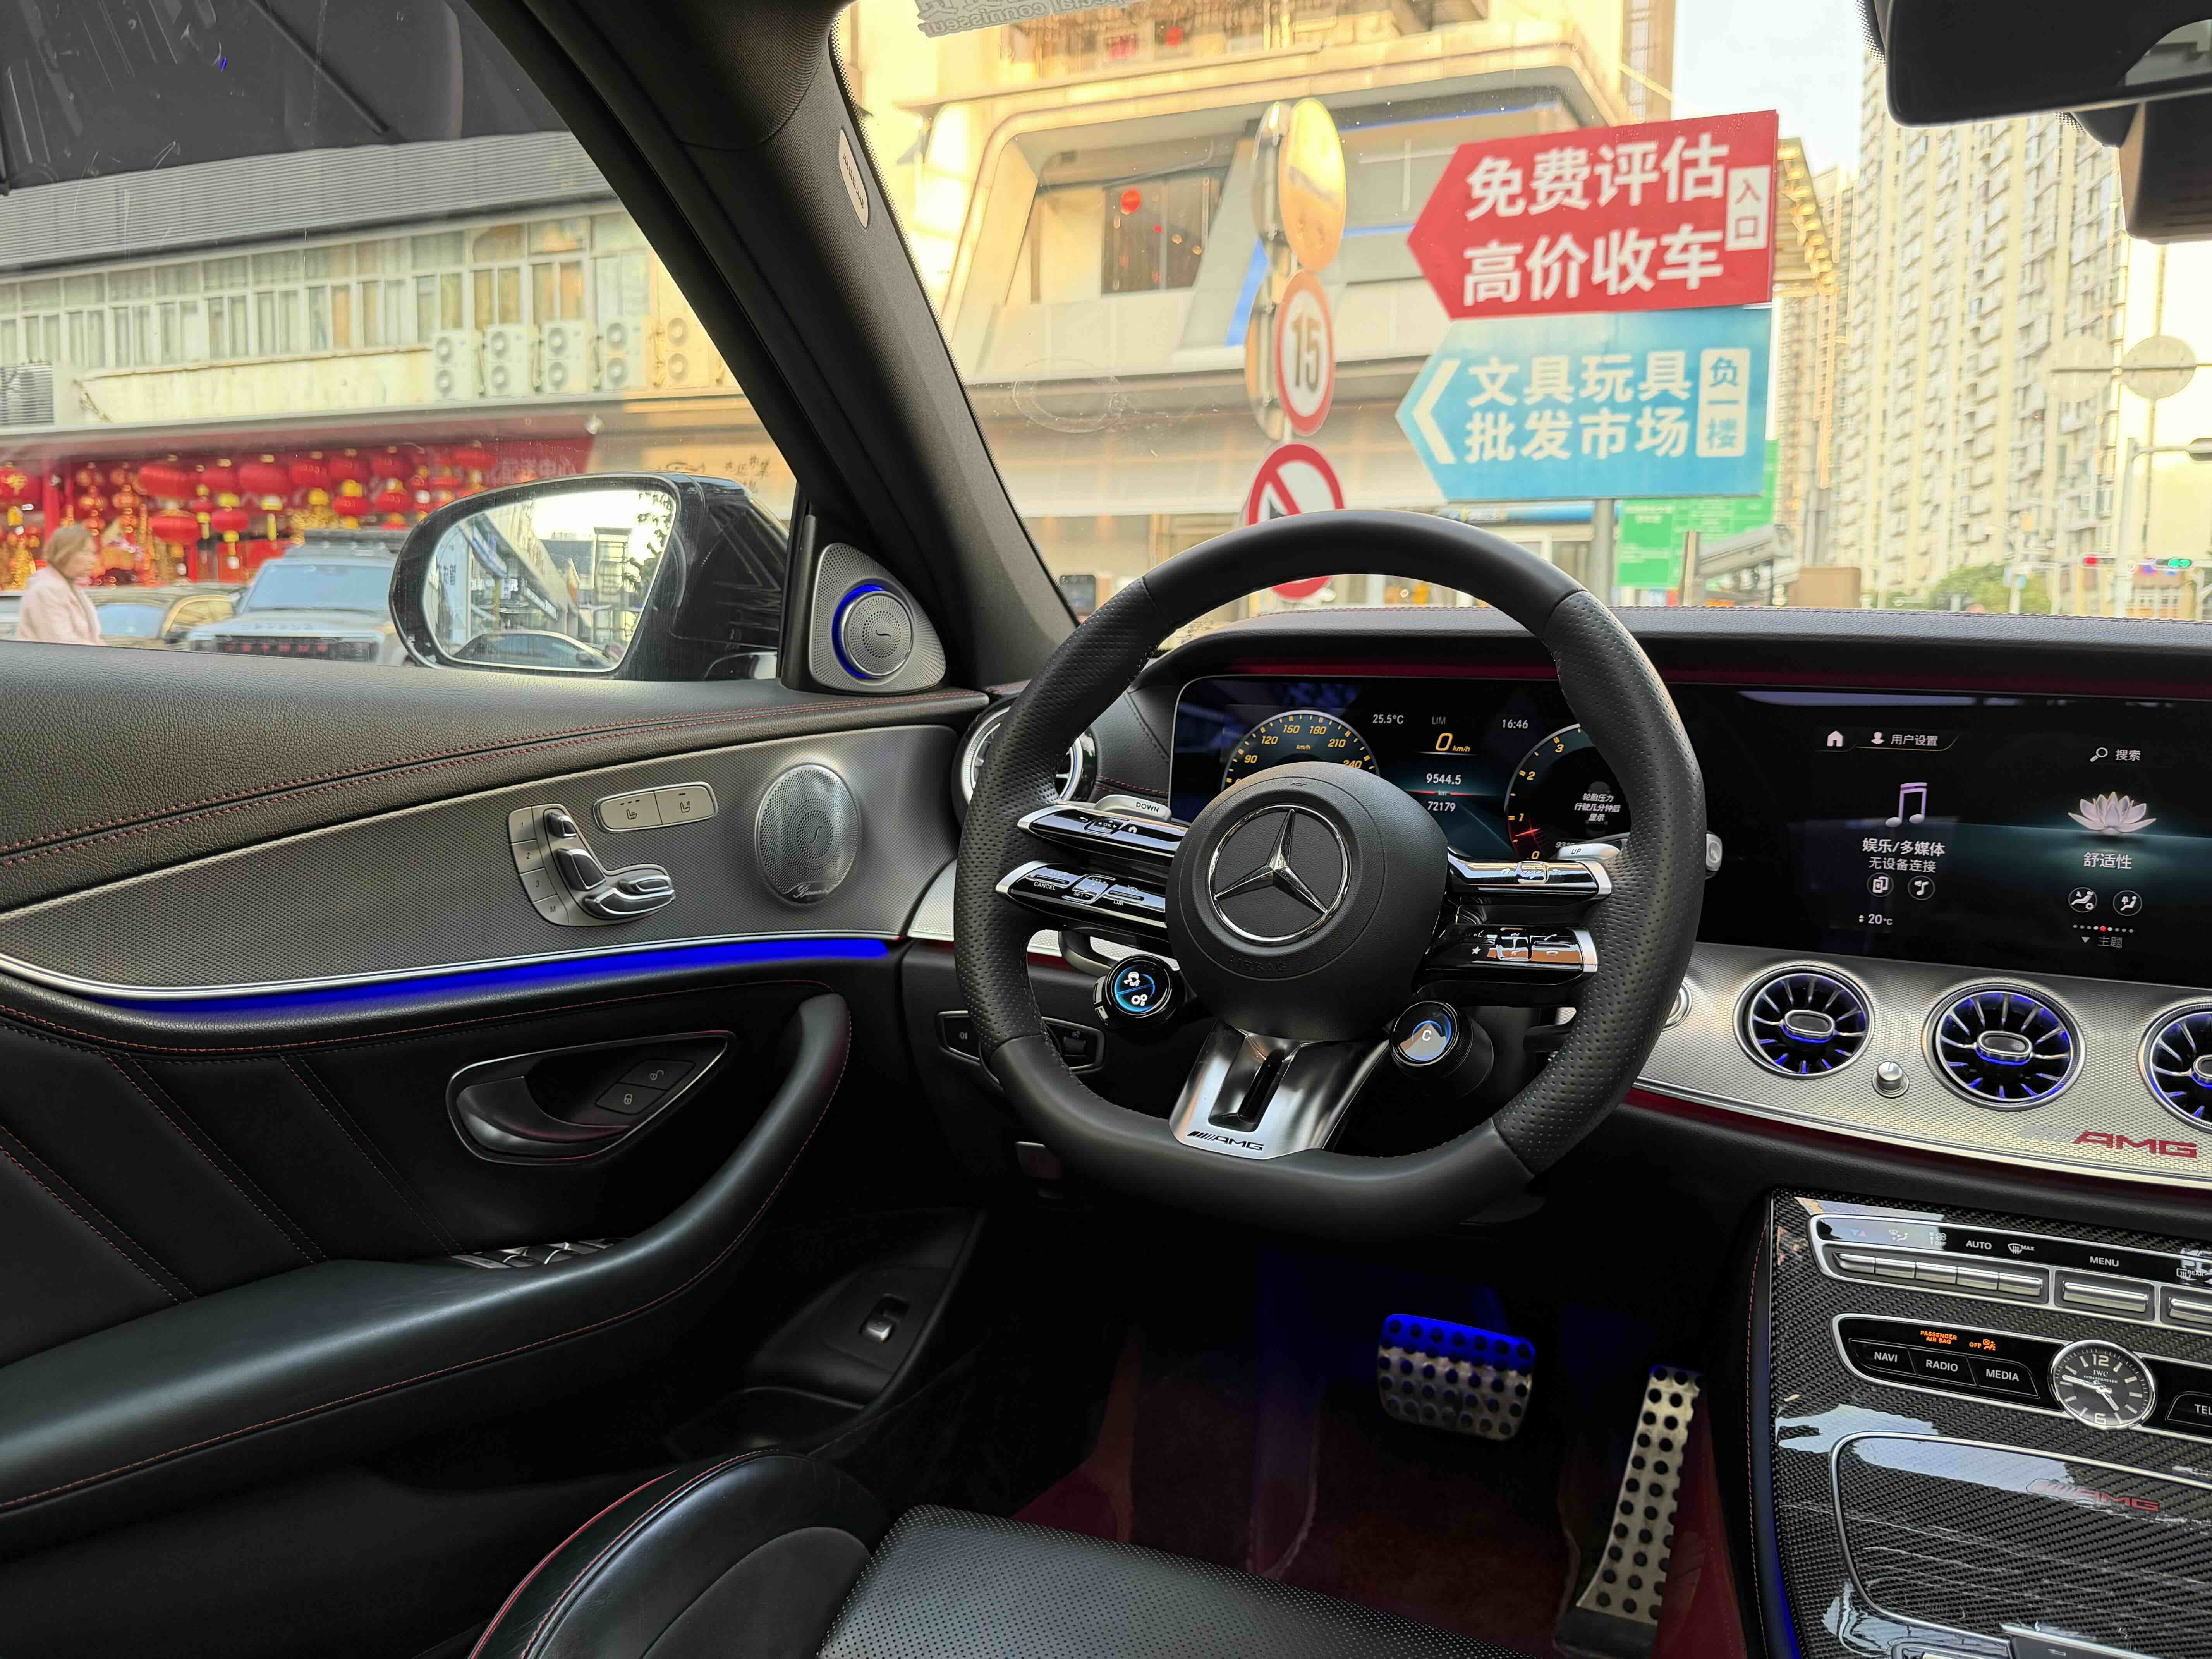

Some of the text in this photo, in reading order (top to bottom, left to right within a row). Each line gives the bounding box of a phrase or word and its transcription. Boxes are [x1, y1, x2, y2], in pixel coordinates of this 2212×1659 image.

[1465, 133, 1729, 221] 免费评估
[1735, 179, 1761, 240] 入口
[1463, 224, 1723, 306] 高价收车
[1291, 316, 1321, 392] 15
[1467, 351, 1691, 407] 文具玩具
[1465, 407, 1689, 460] 批发市场
[1372, 714, 1404, 724] 25.5°C
[1502, 719, 1528, 729] 16:46
[1283, 725, 1300, 733] 150
[1309, 726, 1326, 734] 180
[1262, 736, 1278, 744] 120
[1328, 739, 1346, 748] 210
[1436, 733, 1453, 751] 0
[1890, 733, 1938, 746] 用户设置
[1555, 744, 1564, 752] 3
[2114, 748, 2141, 762] 搜索
[1426, 773, 1462, 785] 9544.5
[1527, 771, 1535, 780] 2
[1582, 793, 1614, 802] 轮胎压力
[1136, 802, 1159, 812] DOWN
[1427, 801, 1456, 812] 72179
[1574, 803, 1621, 812] 行驶几分钟后
[1519, 813, 1524, 821] 1
[1862, 837, 1945, 857] 娱乐/多媒体
[1531, 851, 1540, 859] 0
[2083, 852, 2132, 869] 舒适性
[1868, 857, 1936, 873] 无设备连接
[1034, 881, 1056, 890] CANCEL
[1868, 914, 1893, 926] 20°C
[2098, 936, 2123, 948] 主题
[1422, 1030, 1432, 1042] C
[1212, 1136, 1264, 1151] AMG
[2072, 1130, 2197, 1158] AMG
[1966, 1240, 1992, 1250] AUTO
[2090, 1256, 2119, 1267] MENU
[1920, 1330, 1957, 1340] PASSENGER
[1874, 1352, 1898, 1364] NAVI
[2092, 1354, 2109, 1367] 12
[1925, 1359, 1959, 1373] RADIO
[1985, 1369, 2019, 1382] MEDIA
[2095, 1413, 2106, 1425] 6
[2076, 1489, 2159, 1512] AMG
